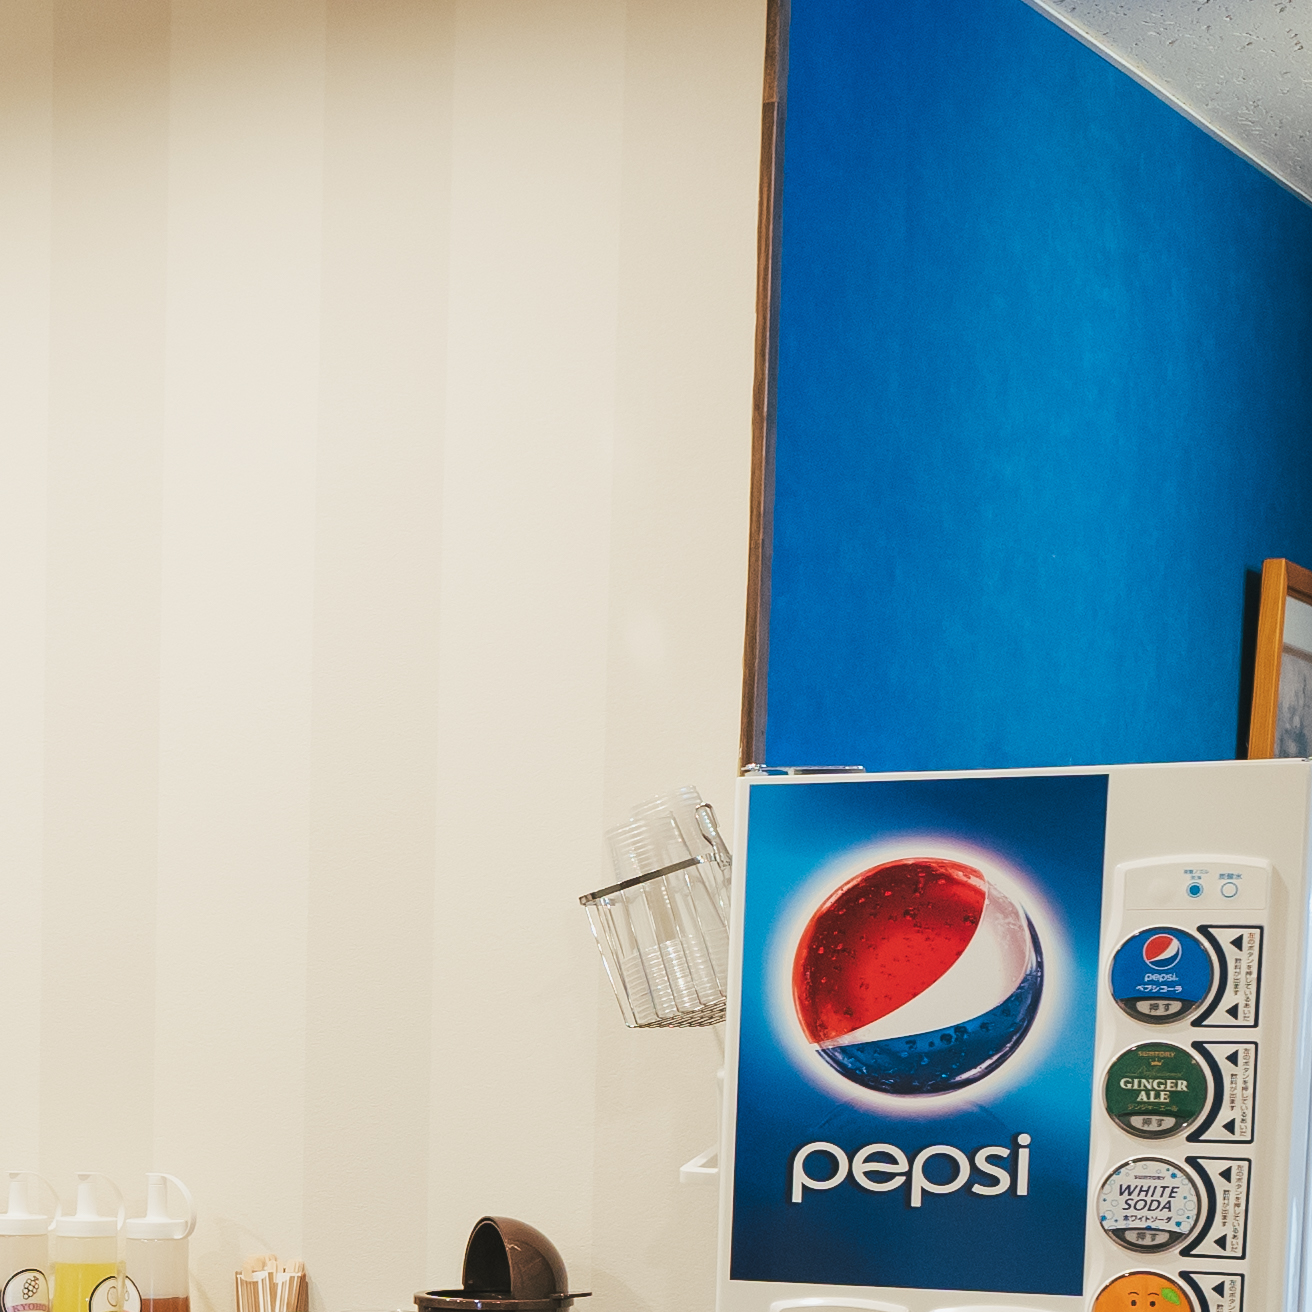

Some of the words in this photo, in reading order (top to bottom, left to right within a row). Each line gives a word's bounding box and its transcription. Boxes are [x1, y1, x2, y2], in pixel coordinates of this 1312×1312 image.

[1136, 985, 1182, 993] ペプシコーラ
[1149, 1003, 1173, 1013] 押す
[1119, 1077, 1189, 1092] GINGER
[1136, 1091, 1170, 1102] ALE
[1142, 1117, 1165, 1127] 押す
[791, 1133, 1032, 1207] pepsi
[1119, 1184, 1180, 1198] WHITE
[1122, 1198, 1172, 1212] SODA
[1122, 1214, 1173, 1223] ホワイトソーダ
[1136, 1232, 1159, 1242] 押す
